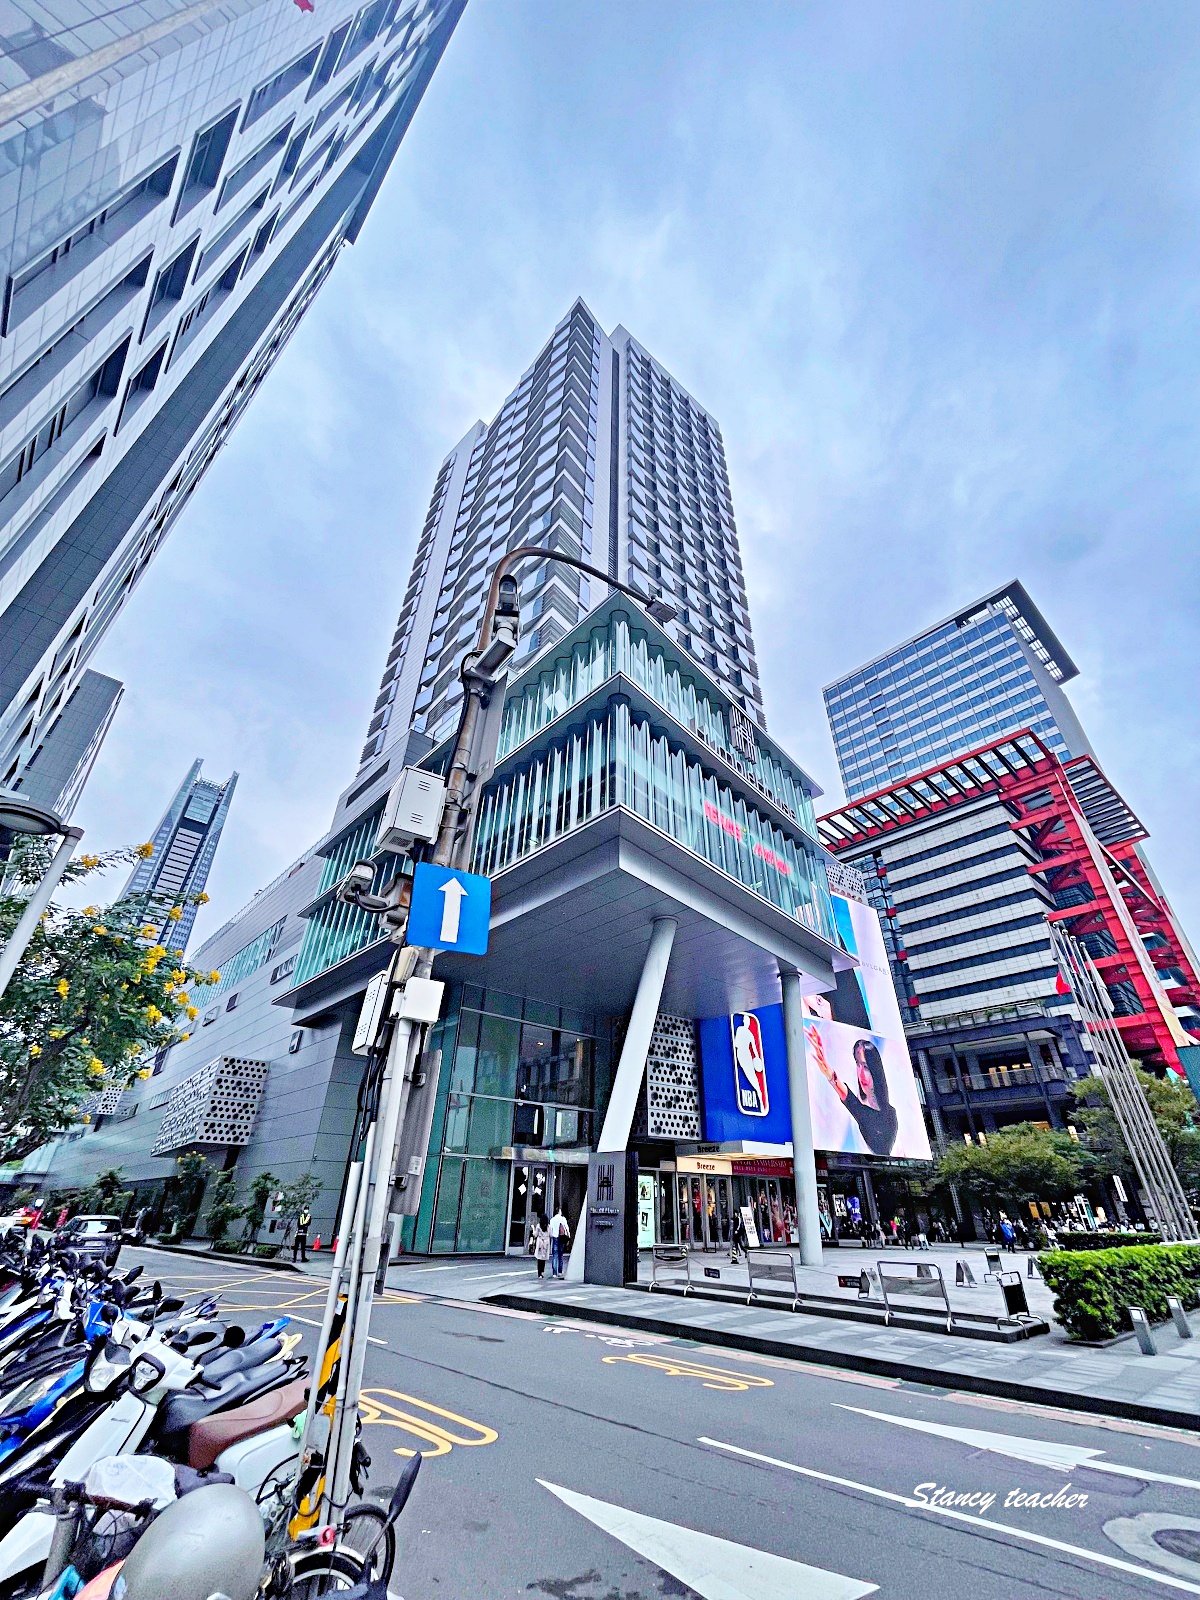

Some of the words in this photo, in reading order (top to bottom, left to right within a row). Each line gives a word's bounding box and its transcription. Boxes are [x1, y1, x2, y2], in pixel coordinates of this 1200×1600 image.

[741, 1089, 758, 1109] NBA
[697, 1145, 720, 1153] Breeze
[696, 1161, 716, 1171] Breeze
